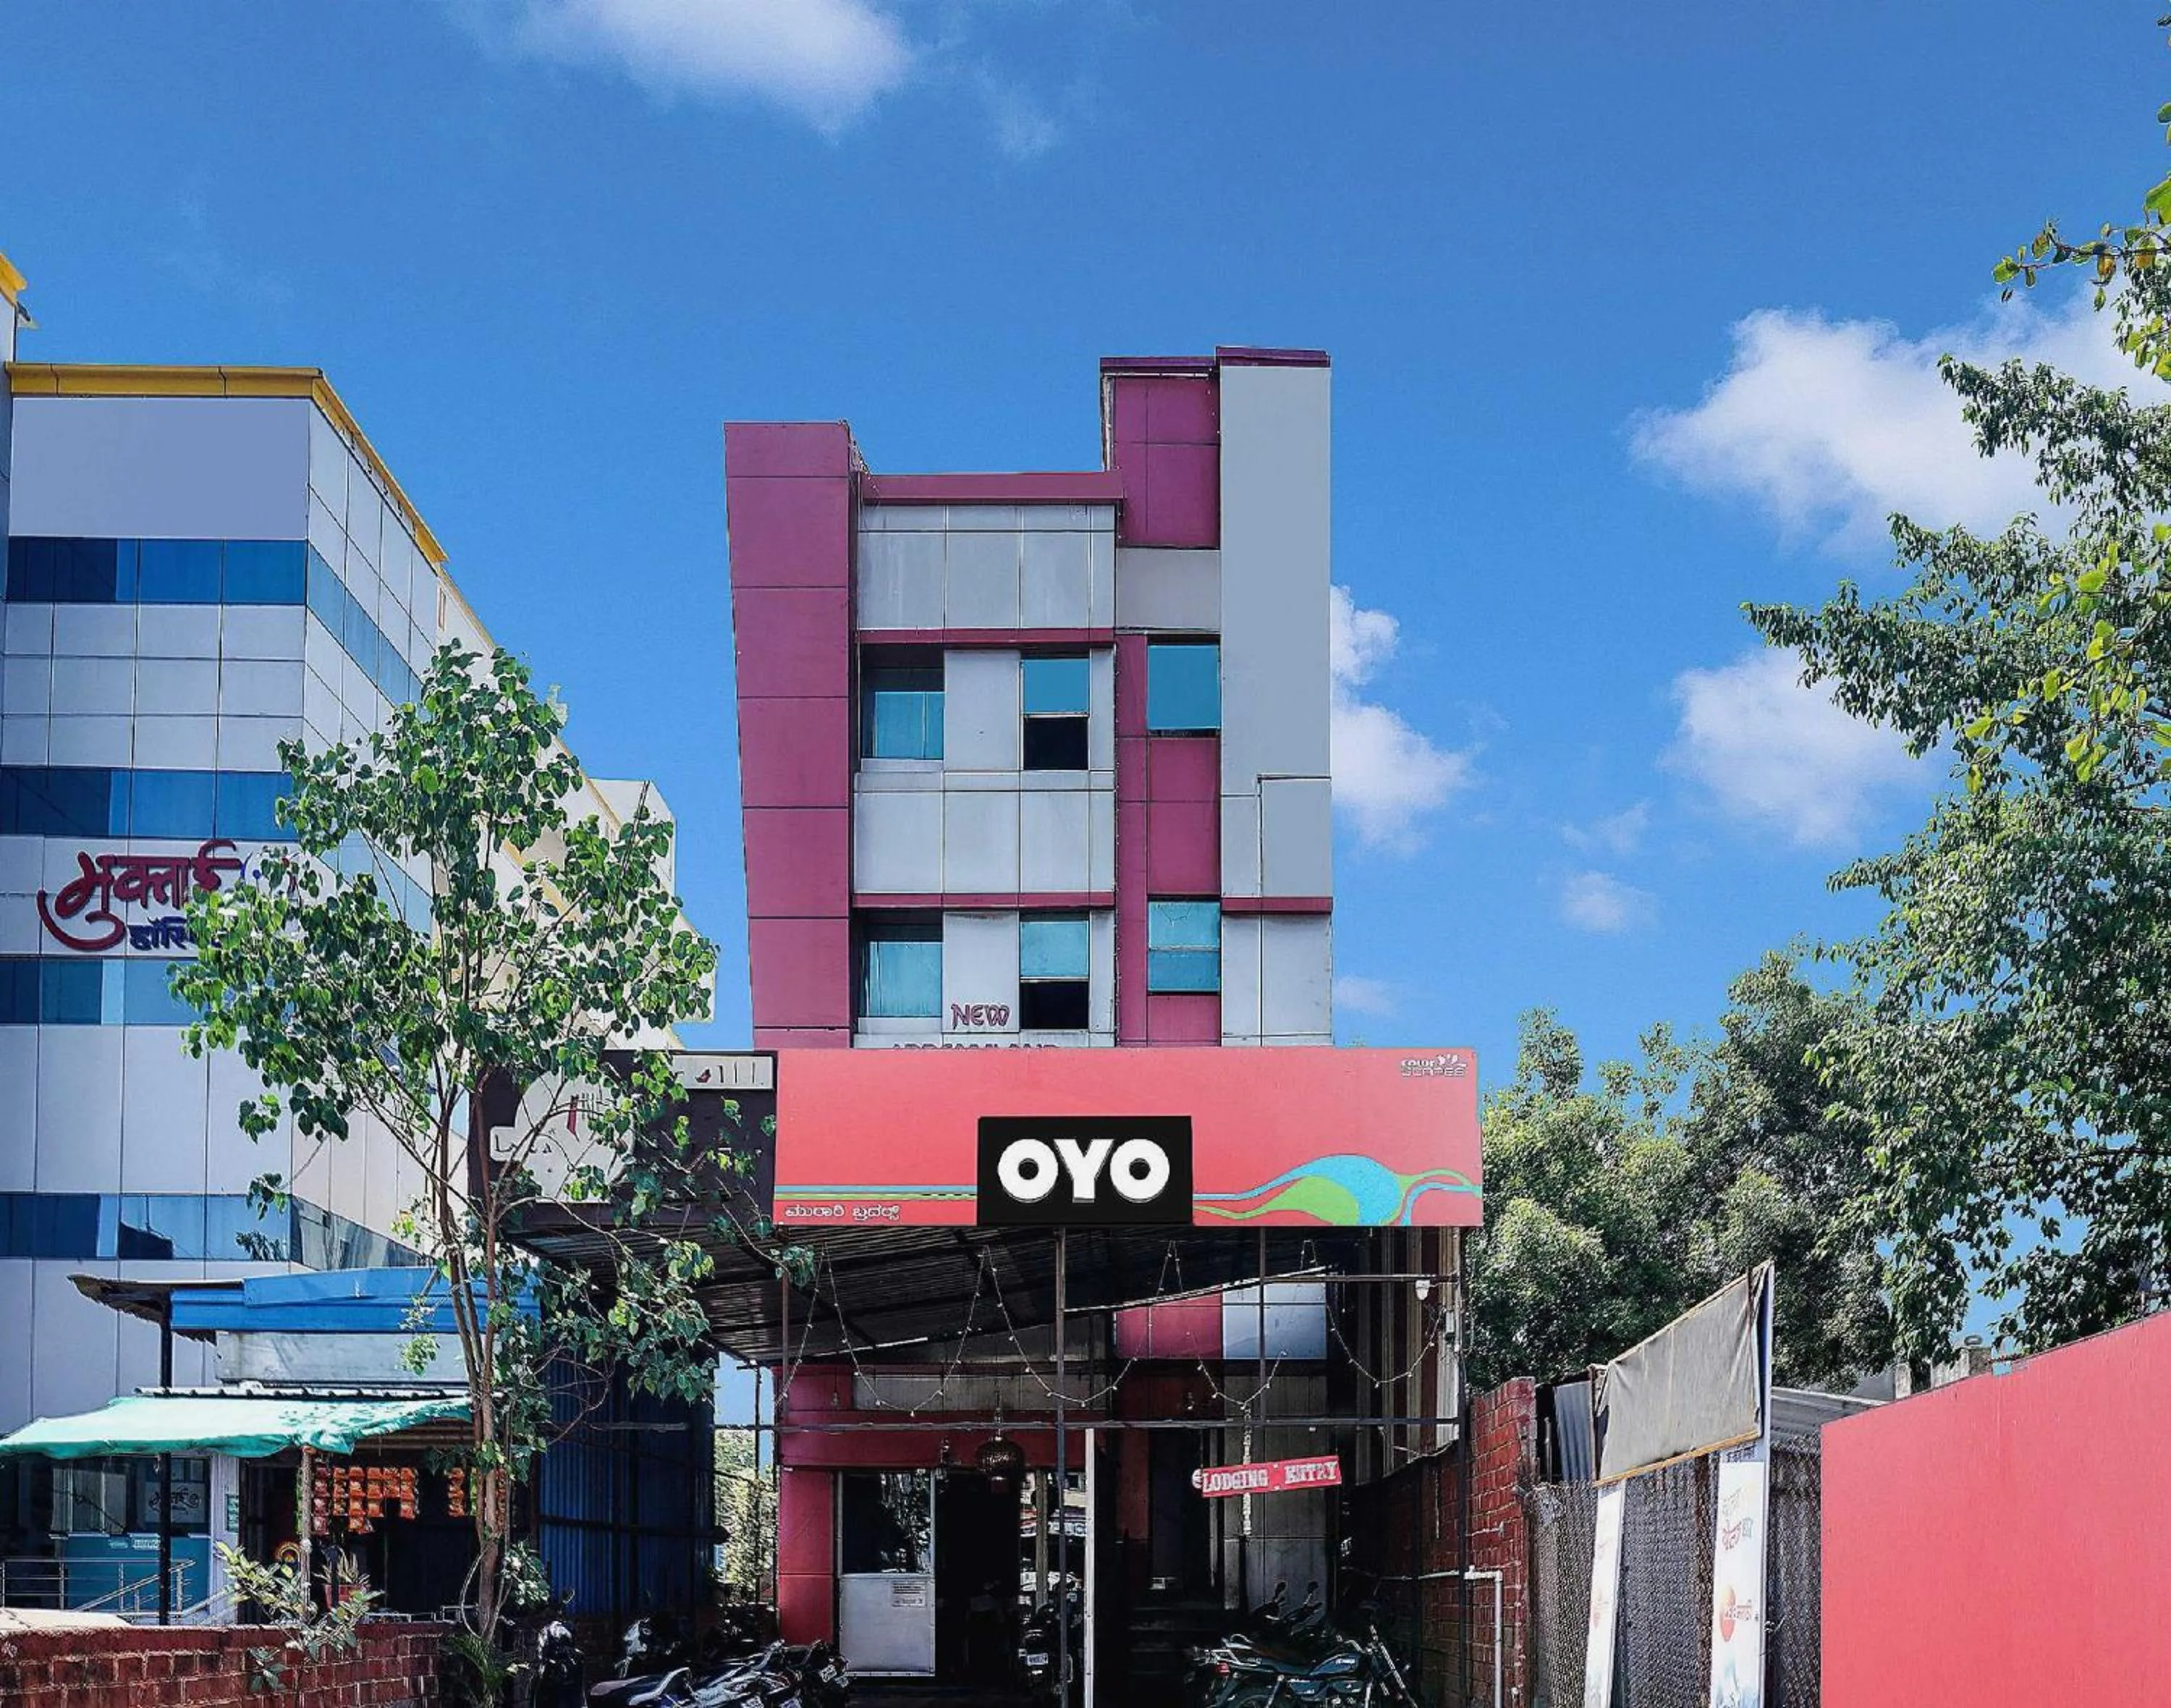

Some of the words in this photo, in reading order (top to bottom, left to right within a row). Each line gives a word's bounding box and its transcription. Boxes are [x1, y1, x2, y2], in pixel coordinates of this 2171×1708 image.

[950, 1003, 1010, 1030] NEW
[997, 1138, 1170, 1203] OYO
[1202, 1468, 1269, 1492] LODGING
[1284, 1460, 1338, 1484] ENTRY
